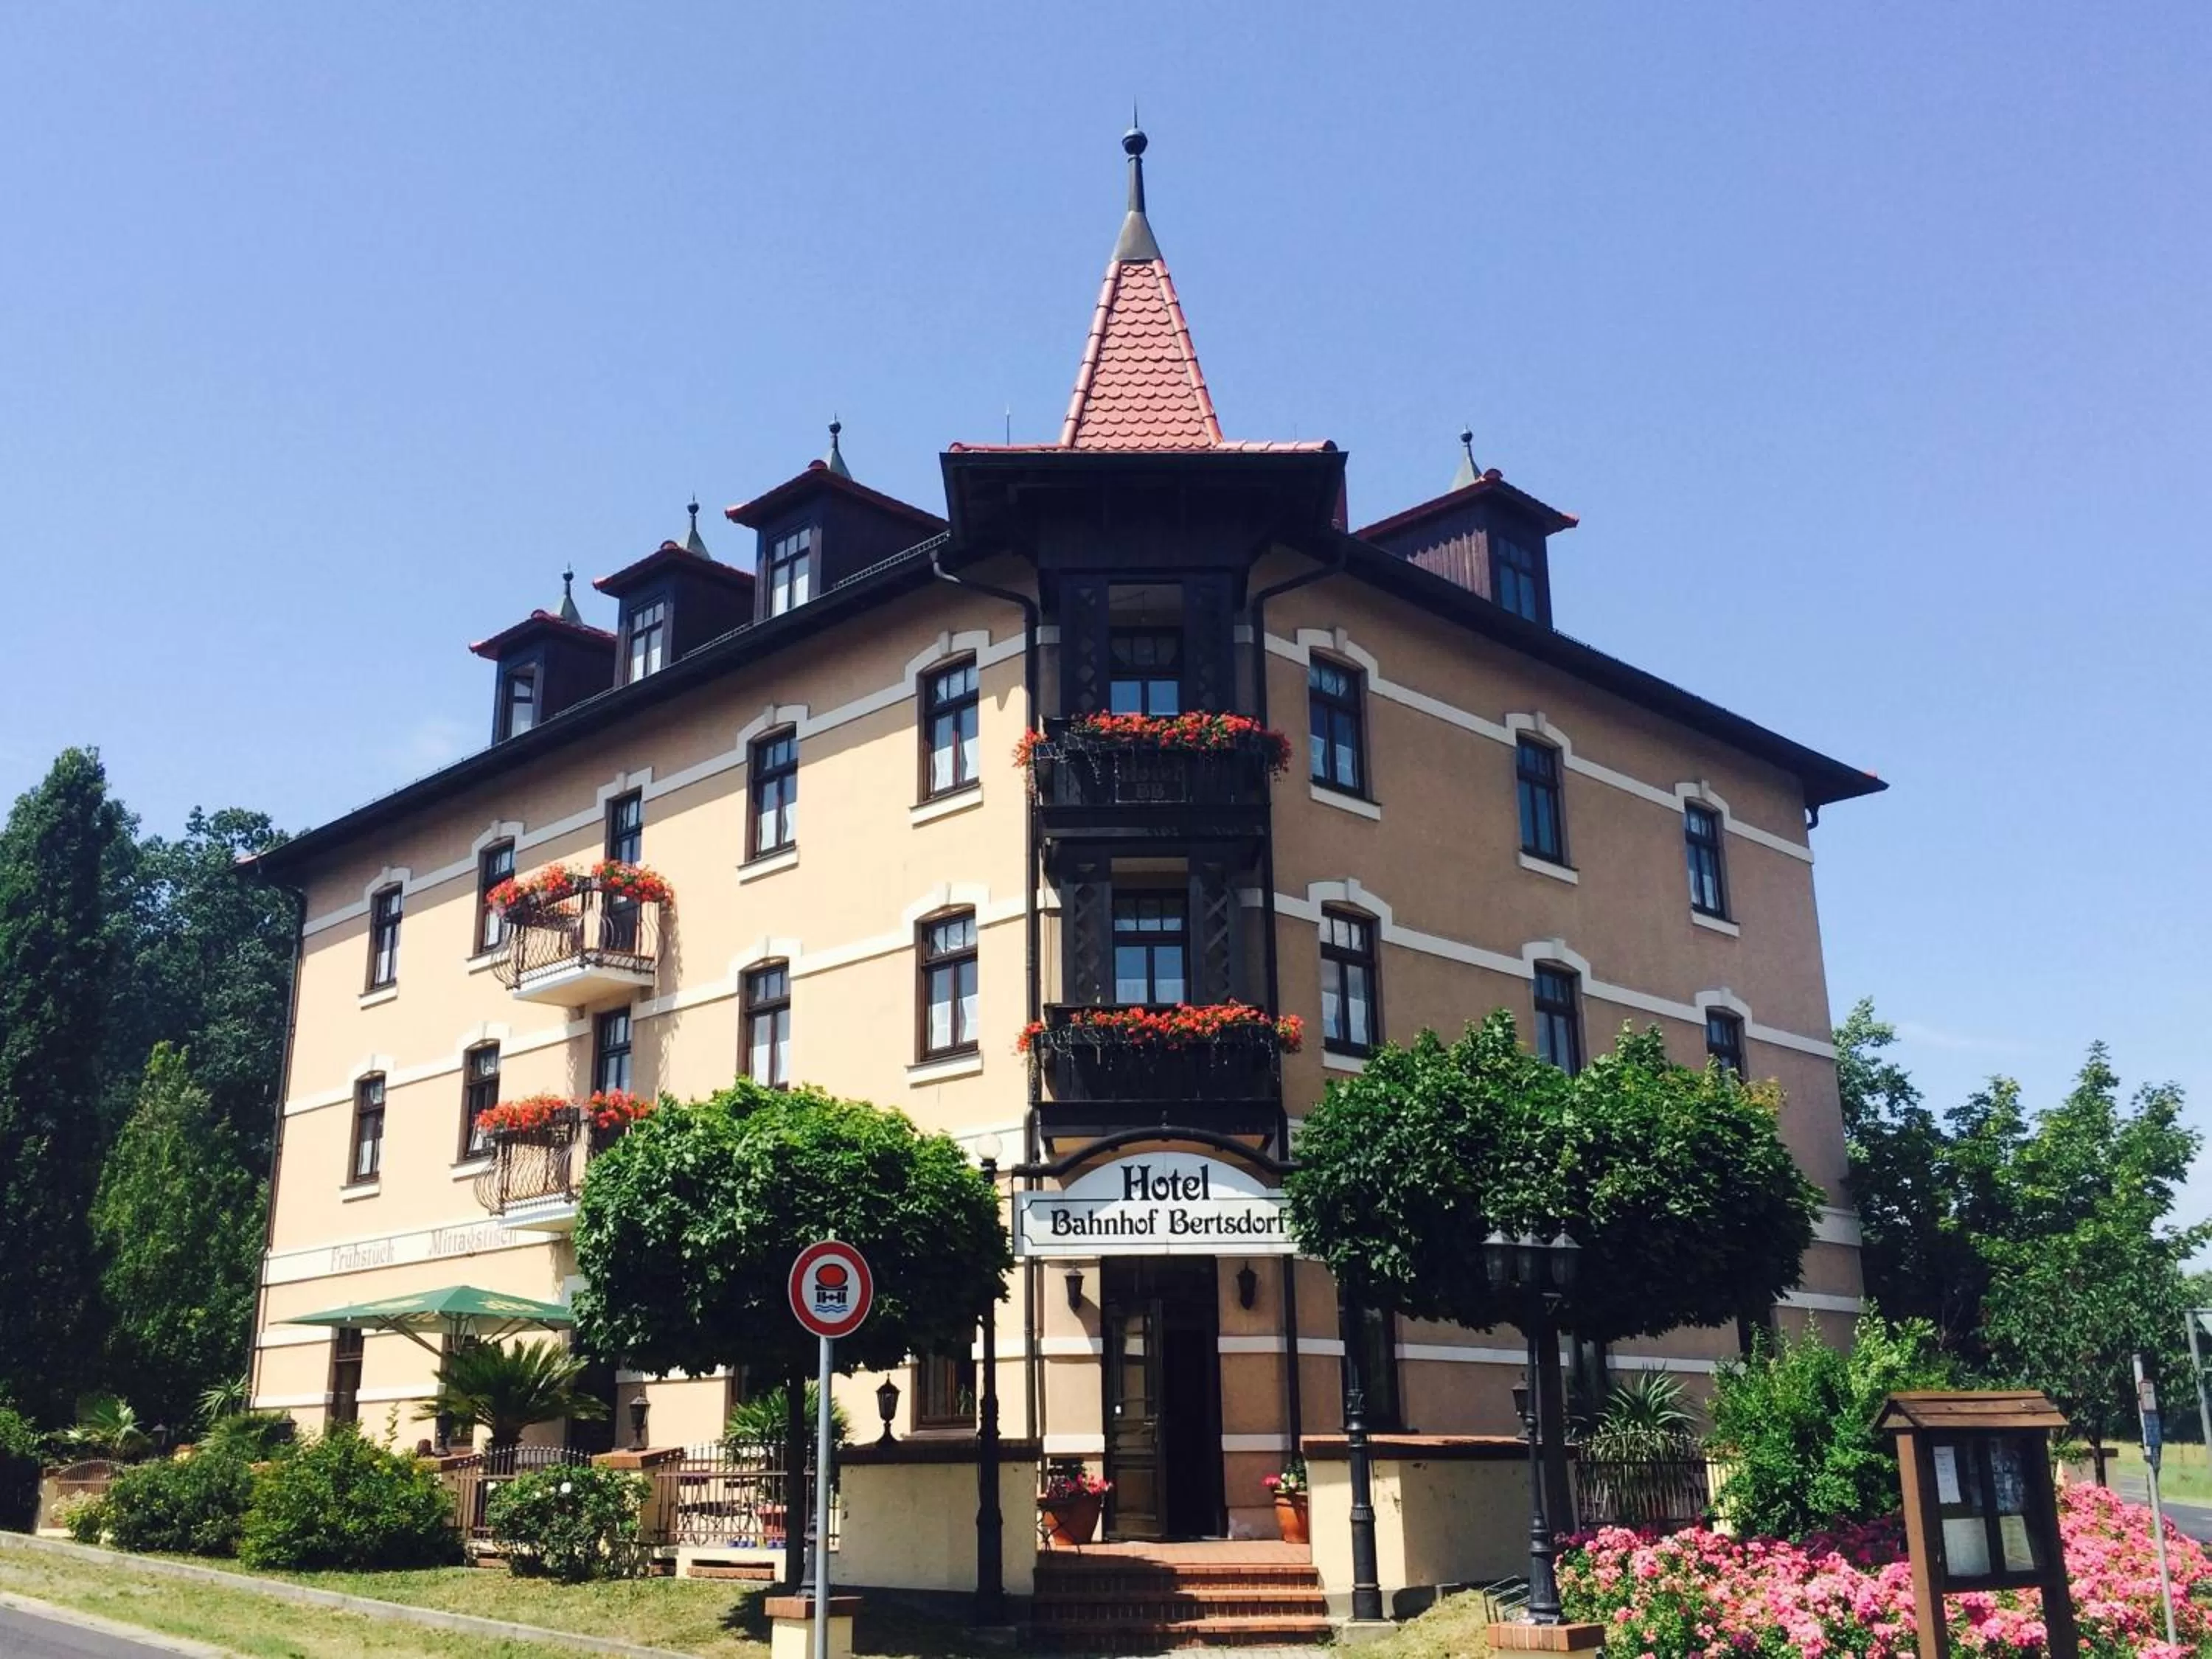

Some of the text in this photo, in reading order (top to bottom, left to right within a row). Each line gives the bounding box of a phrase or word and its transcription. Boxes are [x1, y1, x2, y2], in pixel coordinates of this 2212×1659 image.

[1120, 1164, 1211, 1201] Hotel
[1051, 1207, 1286, 1237] Bahnhof Bertsdorf
